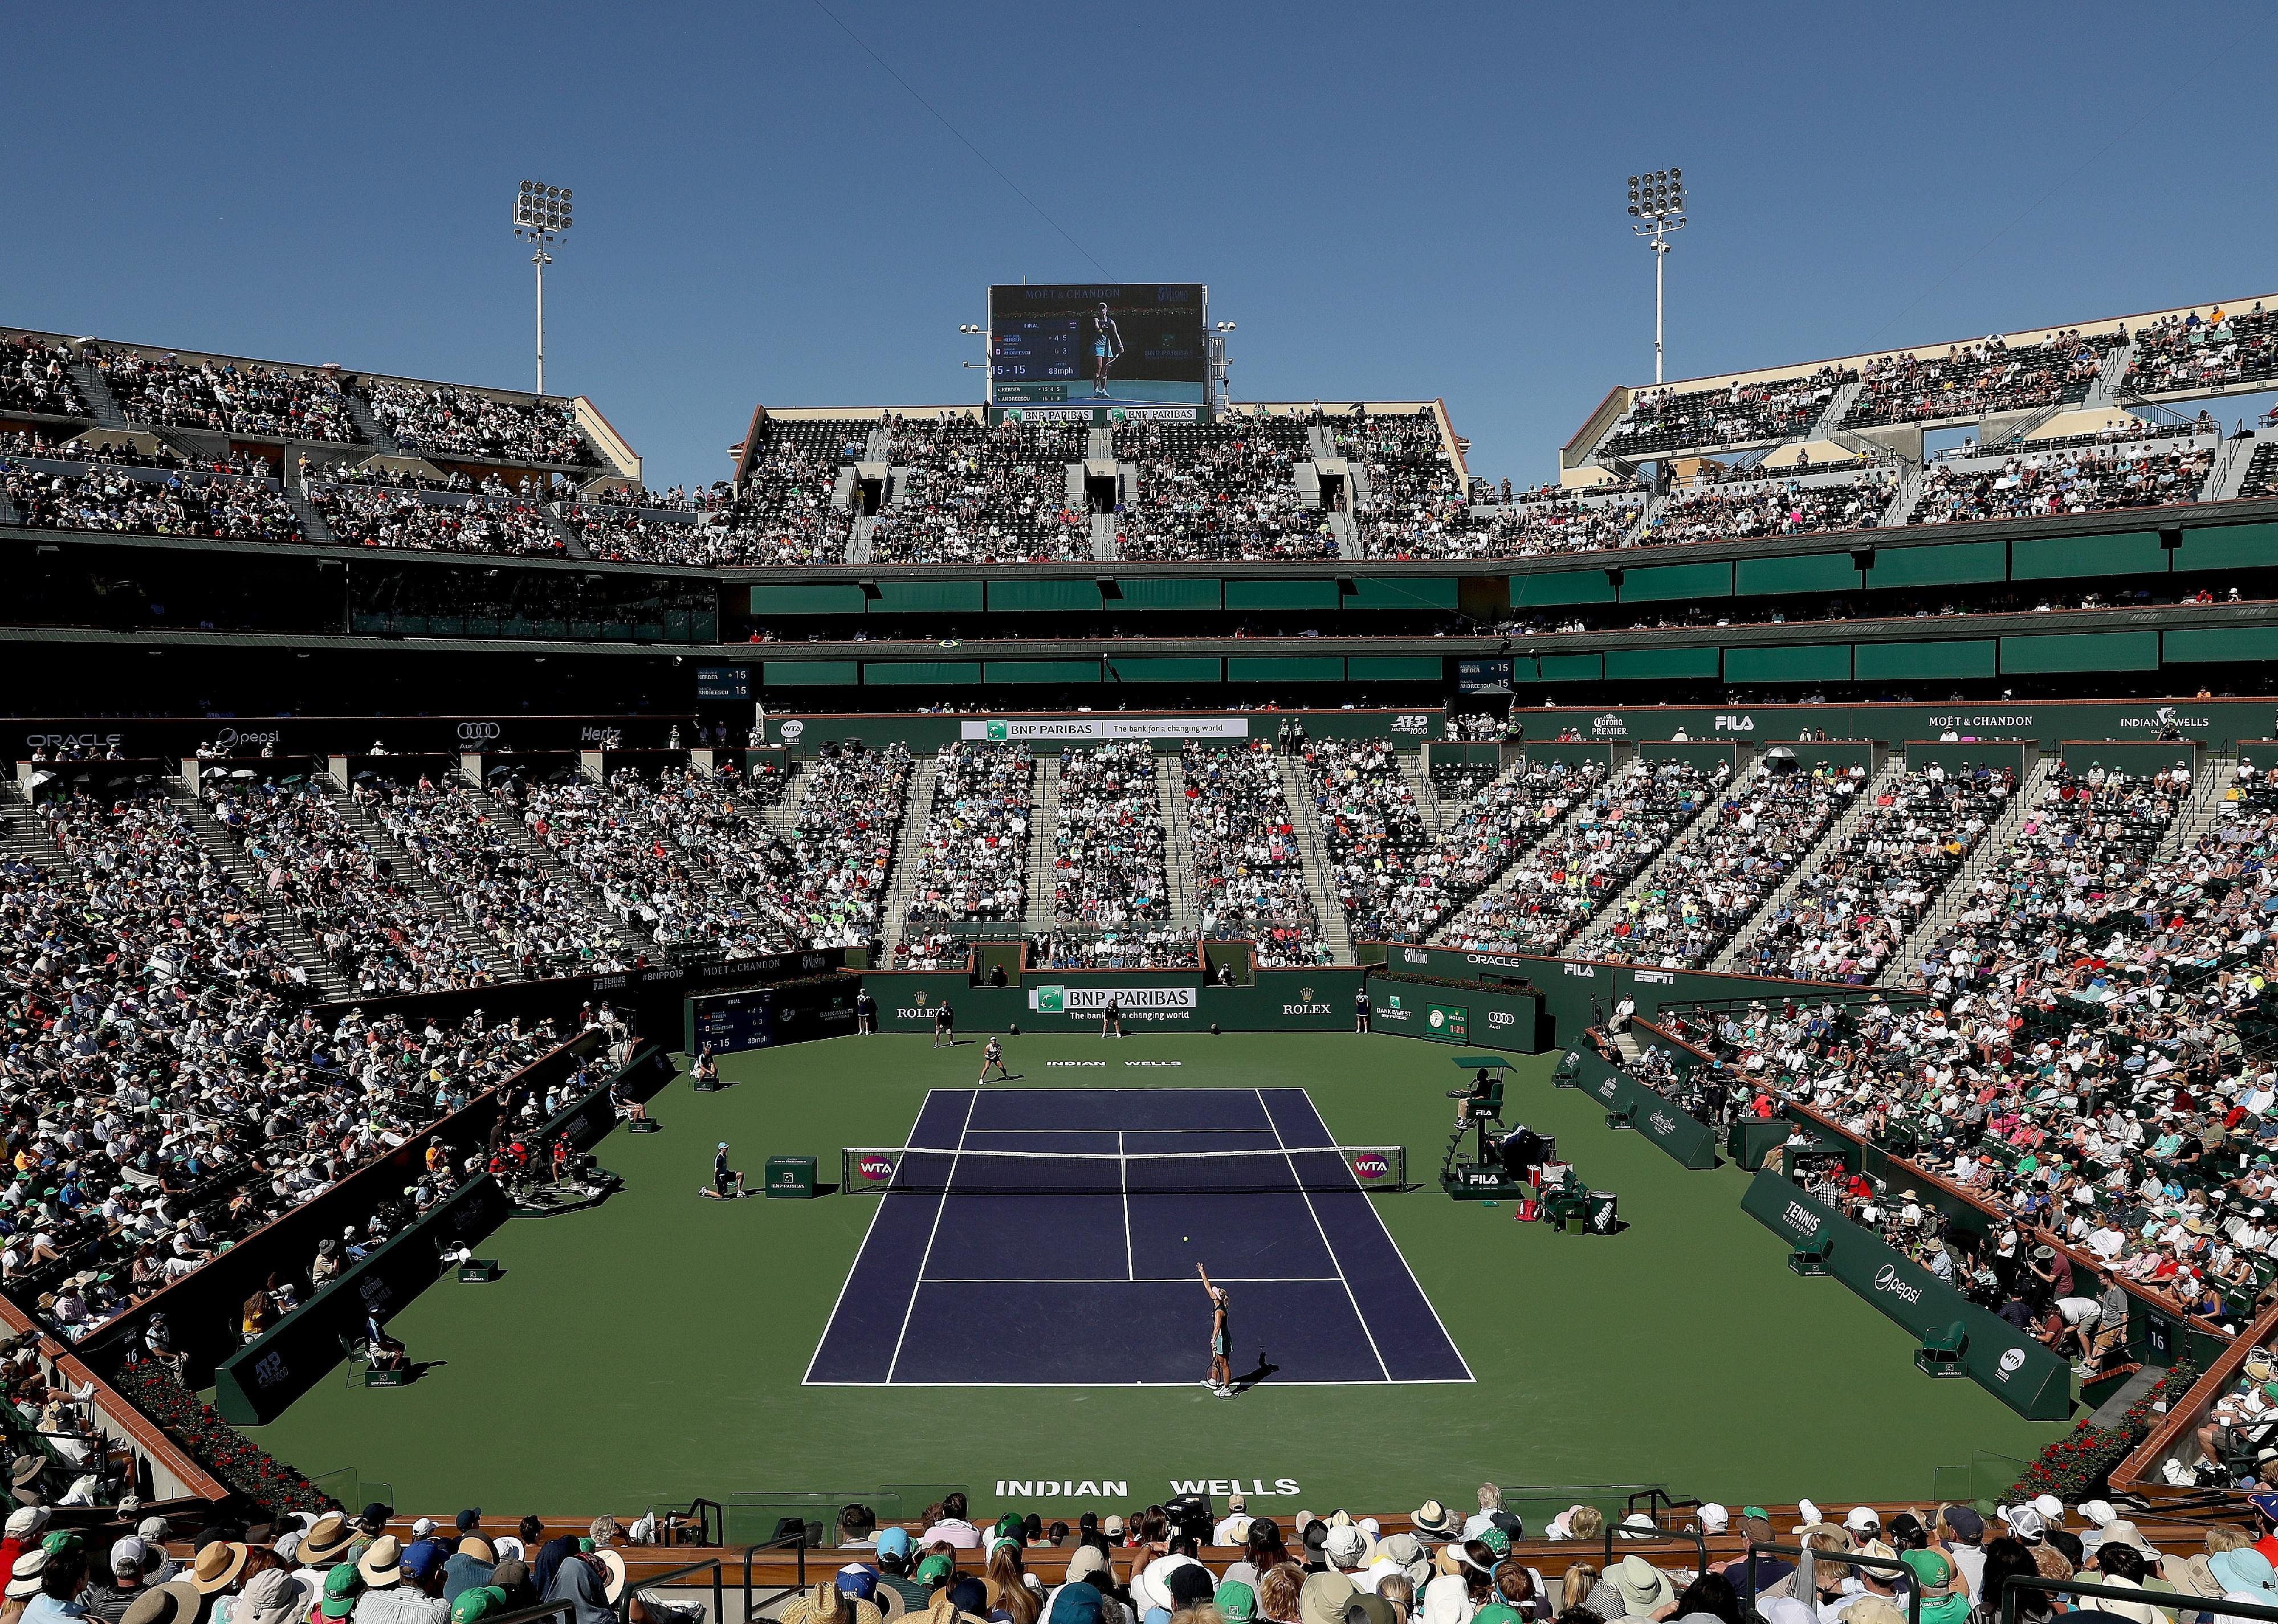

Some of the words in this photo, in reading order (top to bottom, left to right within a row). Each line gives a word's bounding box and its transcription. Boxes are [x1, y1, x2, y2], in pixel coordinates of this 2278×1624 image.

[1066, 289, 1120, 298] CHANDON
[992, 366, 1003, 374] 15
[1014, 365, 1026, 374] 15
[1049, 366, 1073, 376] 88mph
[1049, 411, 1089, 419] PARIBAS
[1128, 410, 1148, 419] BNP
[1152, 410, 1192, 418] PARIBAS
[1498, 663, 1509, 672] 15
[735, 671, 746, 679] 15
[1498, 679, 1509, 688] 15
[1391, 716, 1428, 727] ATP
[1594, 717, 1623, 728] Corona
[1715, 715, 1754, 730] FILA
[1929, 716, 1962, 727] MOËT
[1973, 716, 2034, 726] CHANDON
[2121, 719, 2159, 727] INDIAN
[581, 727, 621, 741] Hertz
[1011, 725, 1036, 735] BNP
[1040, 724, 1092, 734] PARIBAS
[1148, 725, 1159, 733] for
[27, 734, 121, 746] ORACLE
[241, 730, 279, 745] pepsi
[737, 958, 780, 972] CHANDON
[1466, 954, 1518, 968] ORACLE
[1564, 963, 1595, 977] FILA
[604, 976, 626, 985] TENNIS
[1634, 970, 1674, 984] ESPN
[1070, 991, 1106, 1005] BNP
[1114, 990, 1188, 1005] PARIBAS
[1282, 1005, 1331, 1014] ROLEX
[1129, 1011, 1165, 1021] changing
[720, 1038, 730, 1047] 15
[860, 1162, 893, 1173] WTA
[1356, 1161, 1387, 1171] WTA
[1470, 1174, 1498, 1185] FILA
[1786, 1199, 1821, 1231] TENNIS
[1782, 1213, 1814, 1237] WAREHOUSE
[1886, 1277, 1923, 1305] pepsi
[2151, 1331, 2164, 1349] 16
[125, 1348, 137, 1362] 16
[2004, 1351, 2020, 1368] WTA
[995, 1480, 1128, 1497] INDIAN
[1169, 1478, 1301, 1496] WELLS
